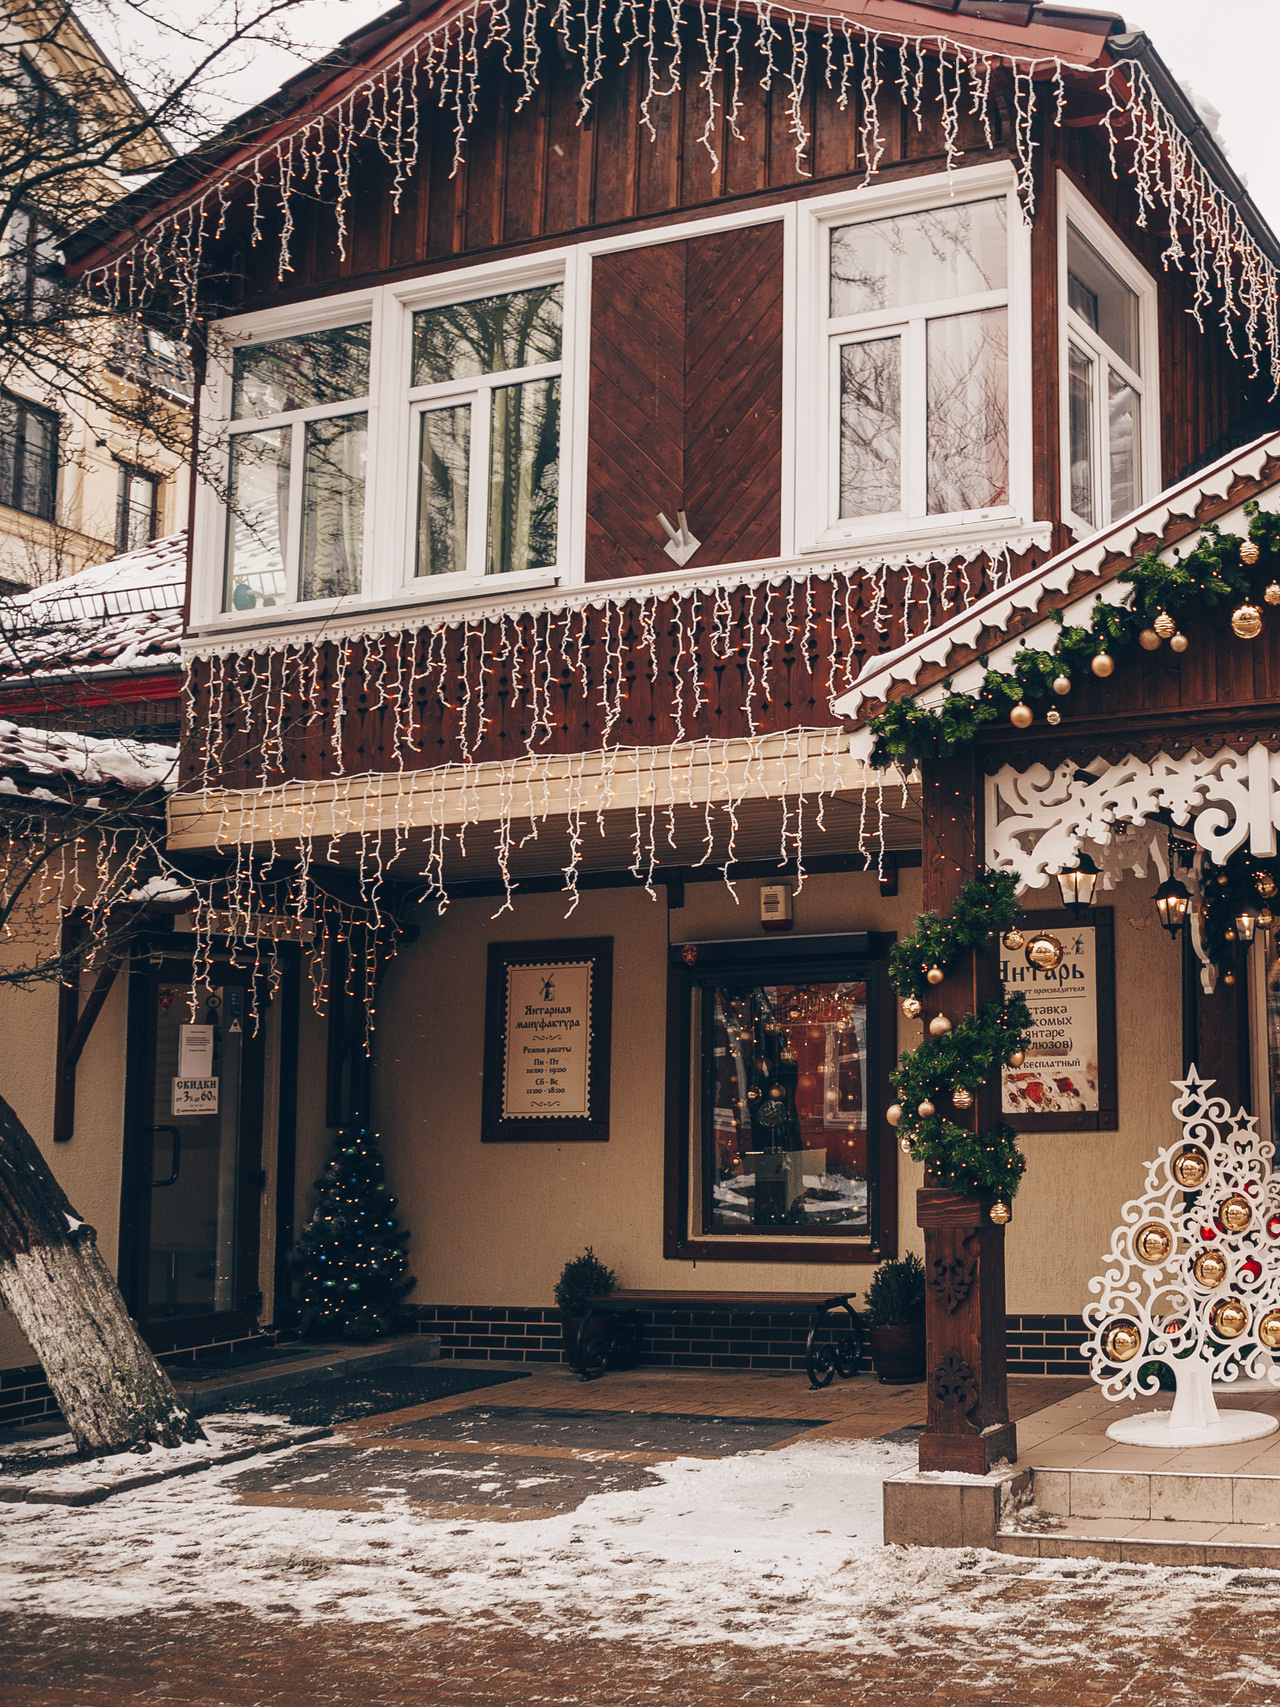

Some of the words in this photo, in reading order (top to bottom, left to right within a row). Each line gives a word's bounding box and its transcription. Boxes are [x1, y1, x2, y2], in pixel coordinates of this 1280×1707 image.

[1033, 986, 1085, 996] производителя
[524, 1005, 572, 1017] Янтарная
[1027, 1005, 1067, 1015] ставка
[516, 1018, 580, 1031] мануфактура
[1033, 1016, 1072, 1027] комых
[1025, 1028, 1065, 1040] янтаре
[1027, 1037, 1073, 1052] люзов)
[523, 1046, 546, 1054] Режим
[549, 1058, 559, 1066] Пт
[176, 1080, 217, 1090] СКИДКИ
[535, 1078, 545, 1086] Сб
[550, 1078, 559, 1086] Вс
